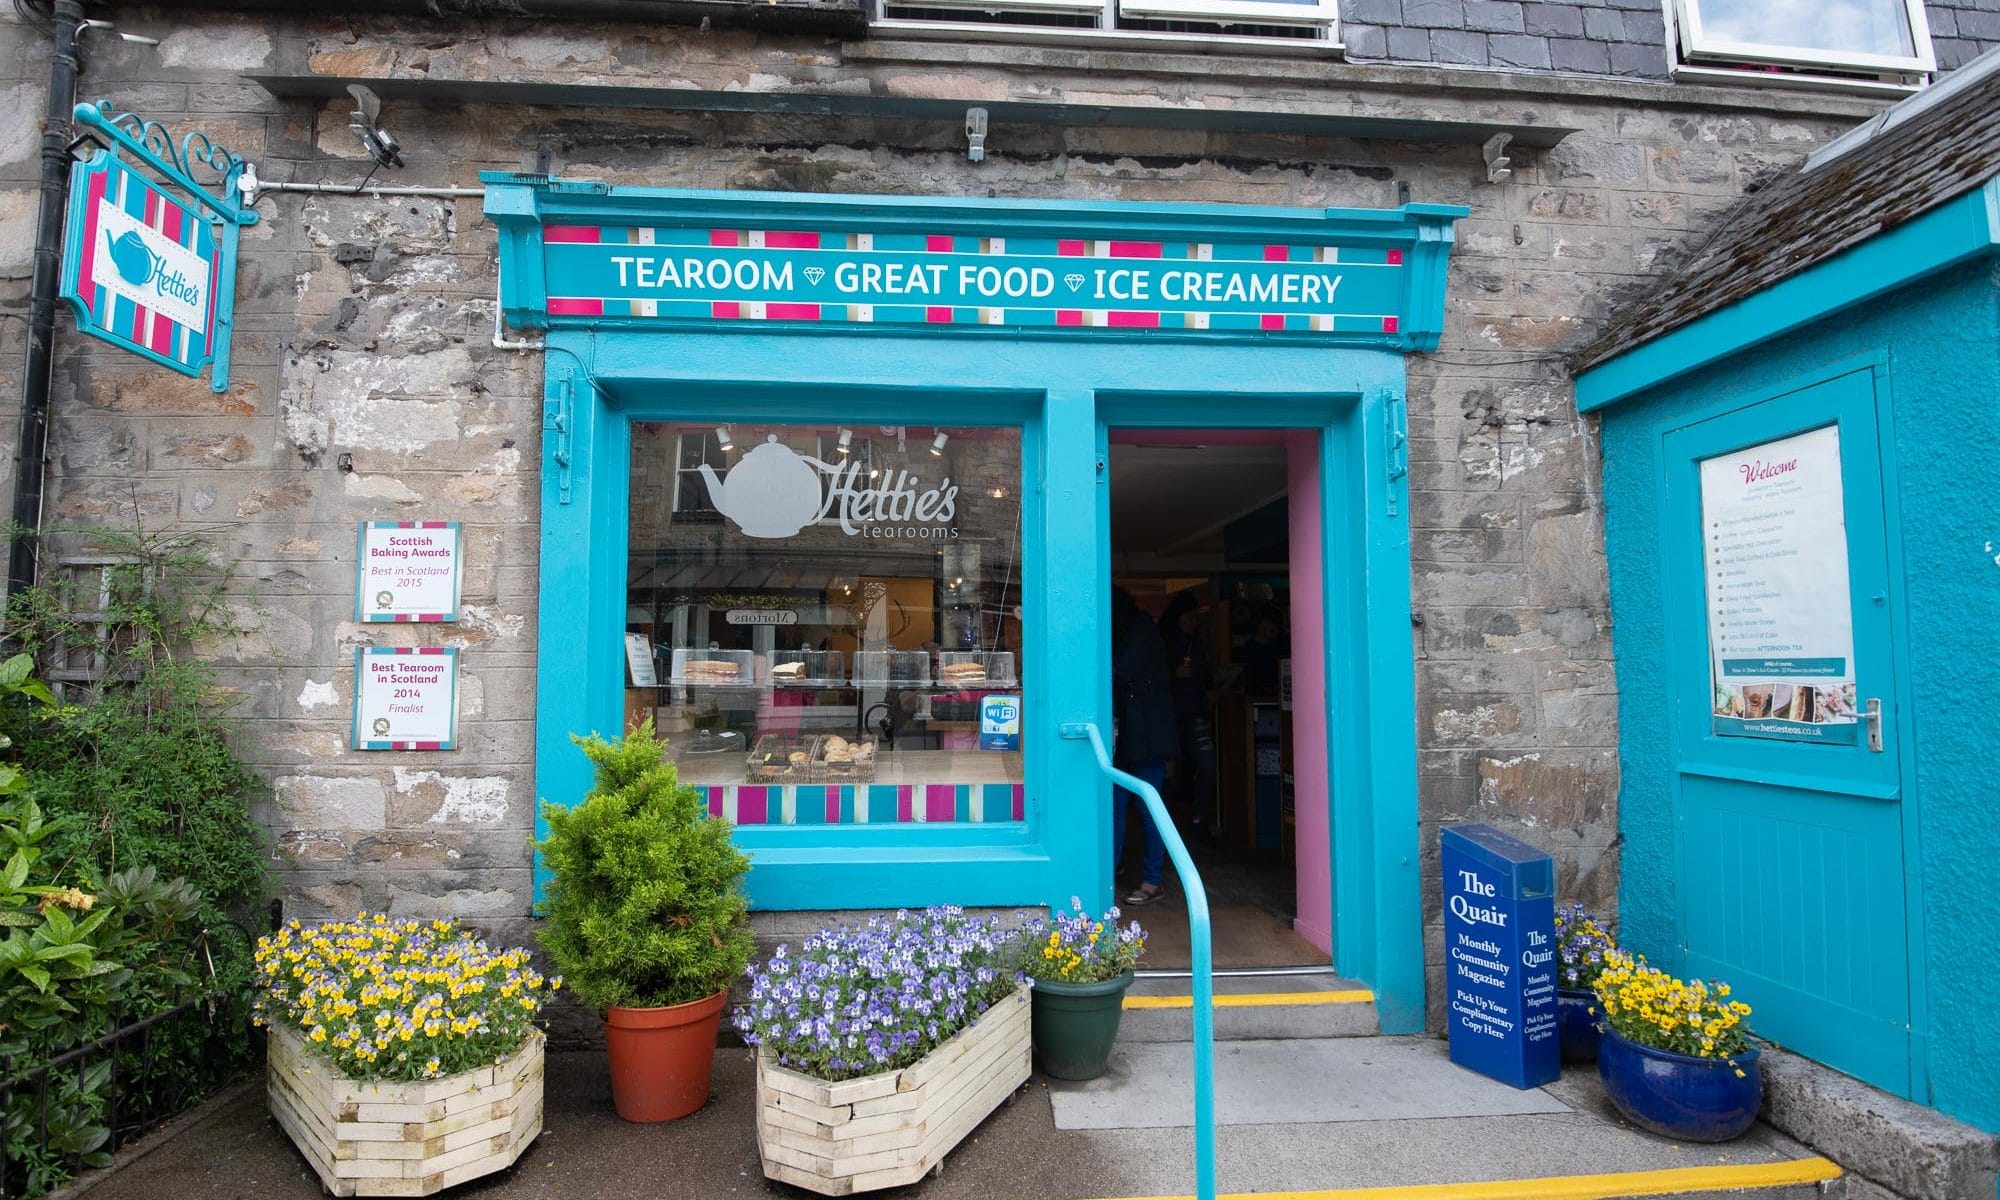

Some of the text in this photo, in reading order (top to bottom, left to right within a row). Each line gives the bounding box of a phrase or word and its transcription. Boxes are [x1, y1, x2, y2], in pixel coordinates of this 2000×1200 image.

[150, 256, 199, 306] Hettie's
[611, 256, 1342, 304] TEAROOM GREAT FOOD ICE CREAMERY
[1739, 458, 1798, 485] Welcome
[822, 457, 959, 536] Hettie's
[389, 536, 433, 546] Scottish
[862, 524, 959, 539] tearooms
[371, 548, 451, 559] Baking Awards
[371, 566, 450, 576] Best in Scotland
[396, 578, 422, 588] 2015
[371, 663, 444, 672] Best Tearoom
[377, 674, 438, 684] in Scotland
[393, 689, 421, 698] 2014
[388, 703, 424, 713] Finalist
[1458, 869, 1496, 898] The
[1450, 895, 1508, 927] Quair
[1458, 933, 1502, 958] Monthly
[1527, 930, 1547, 946] The
[1451, 947, 1510, 976] Community
[1522, 948, 1553, 968] Quair
[1457, 963, 1506, 988] Magazine
[1527, 973, 1550, 986] Monthly
[1456, 989, 1508, 1015] Pick Up Your
[1452, 1000, 1514, 1032] Complimentary
[1462, 1016, 1505, 1040] Copy Here
